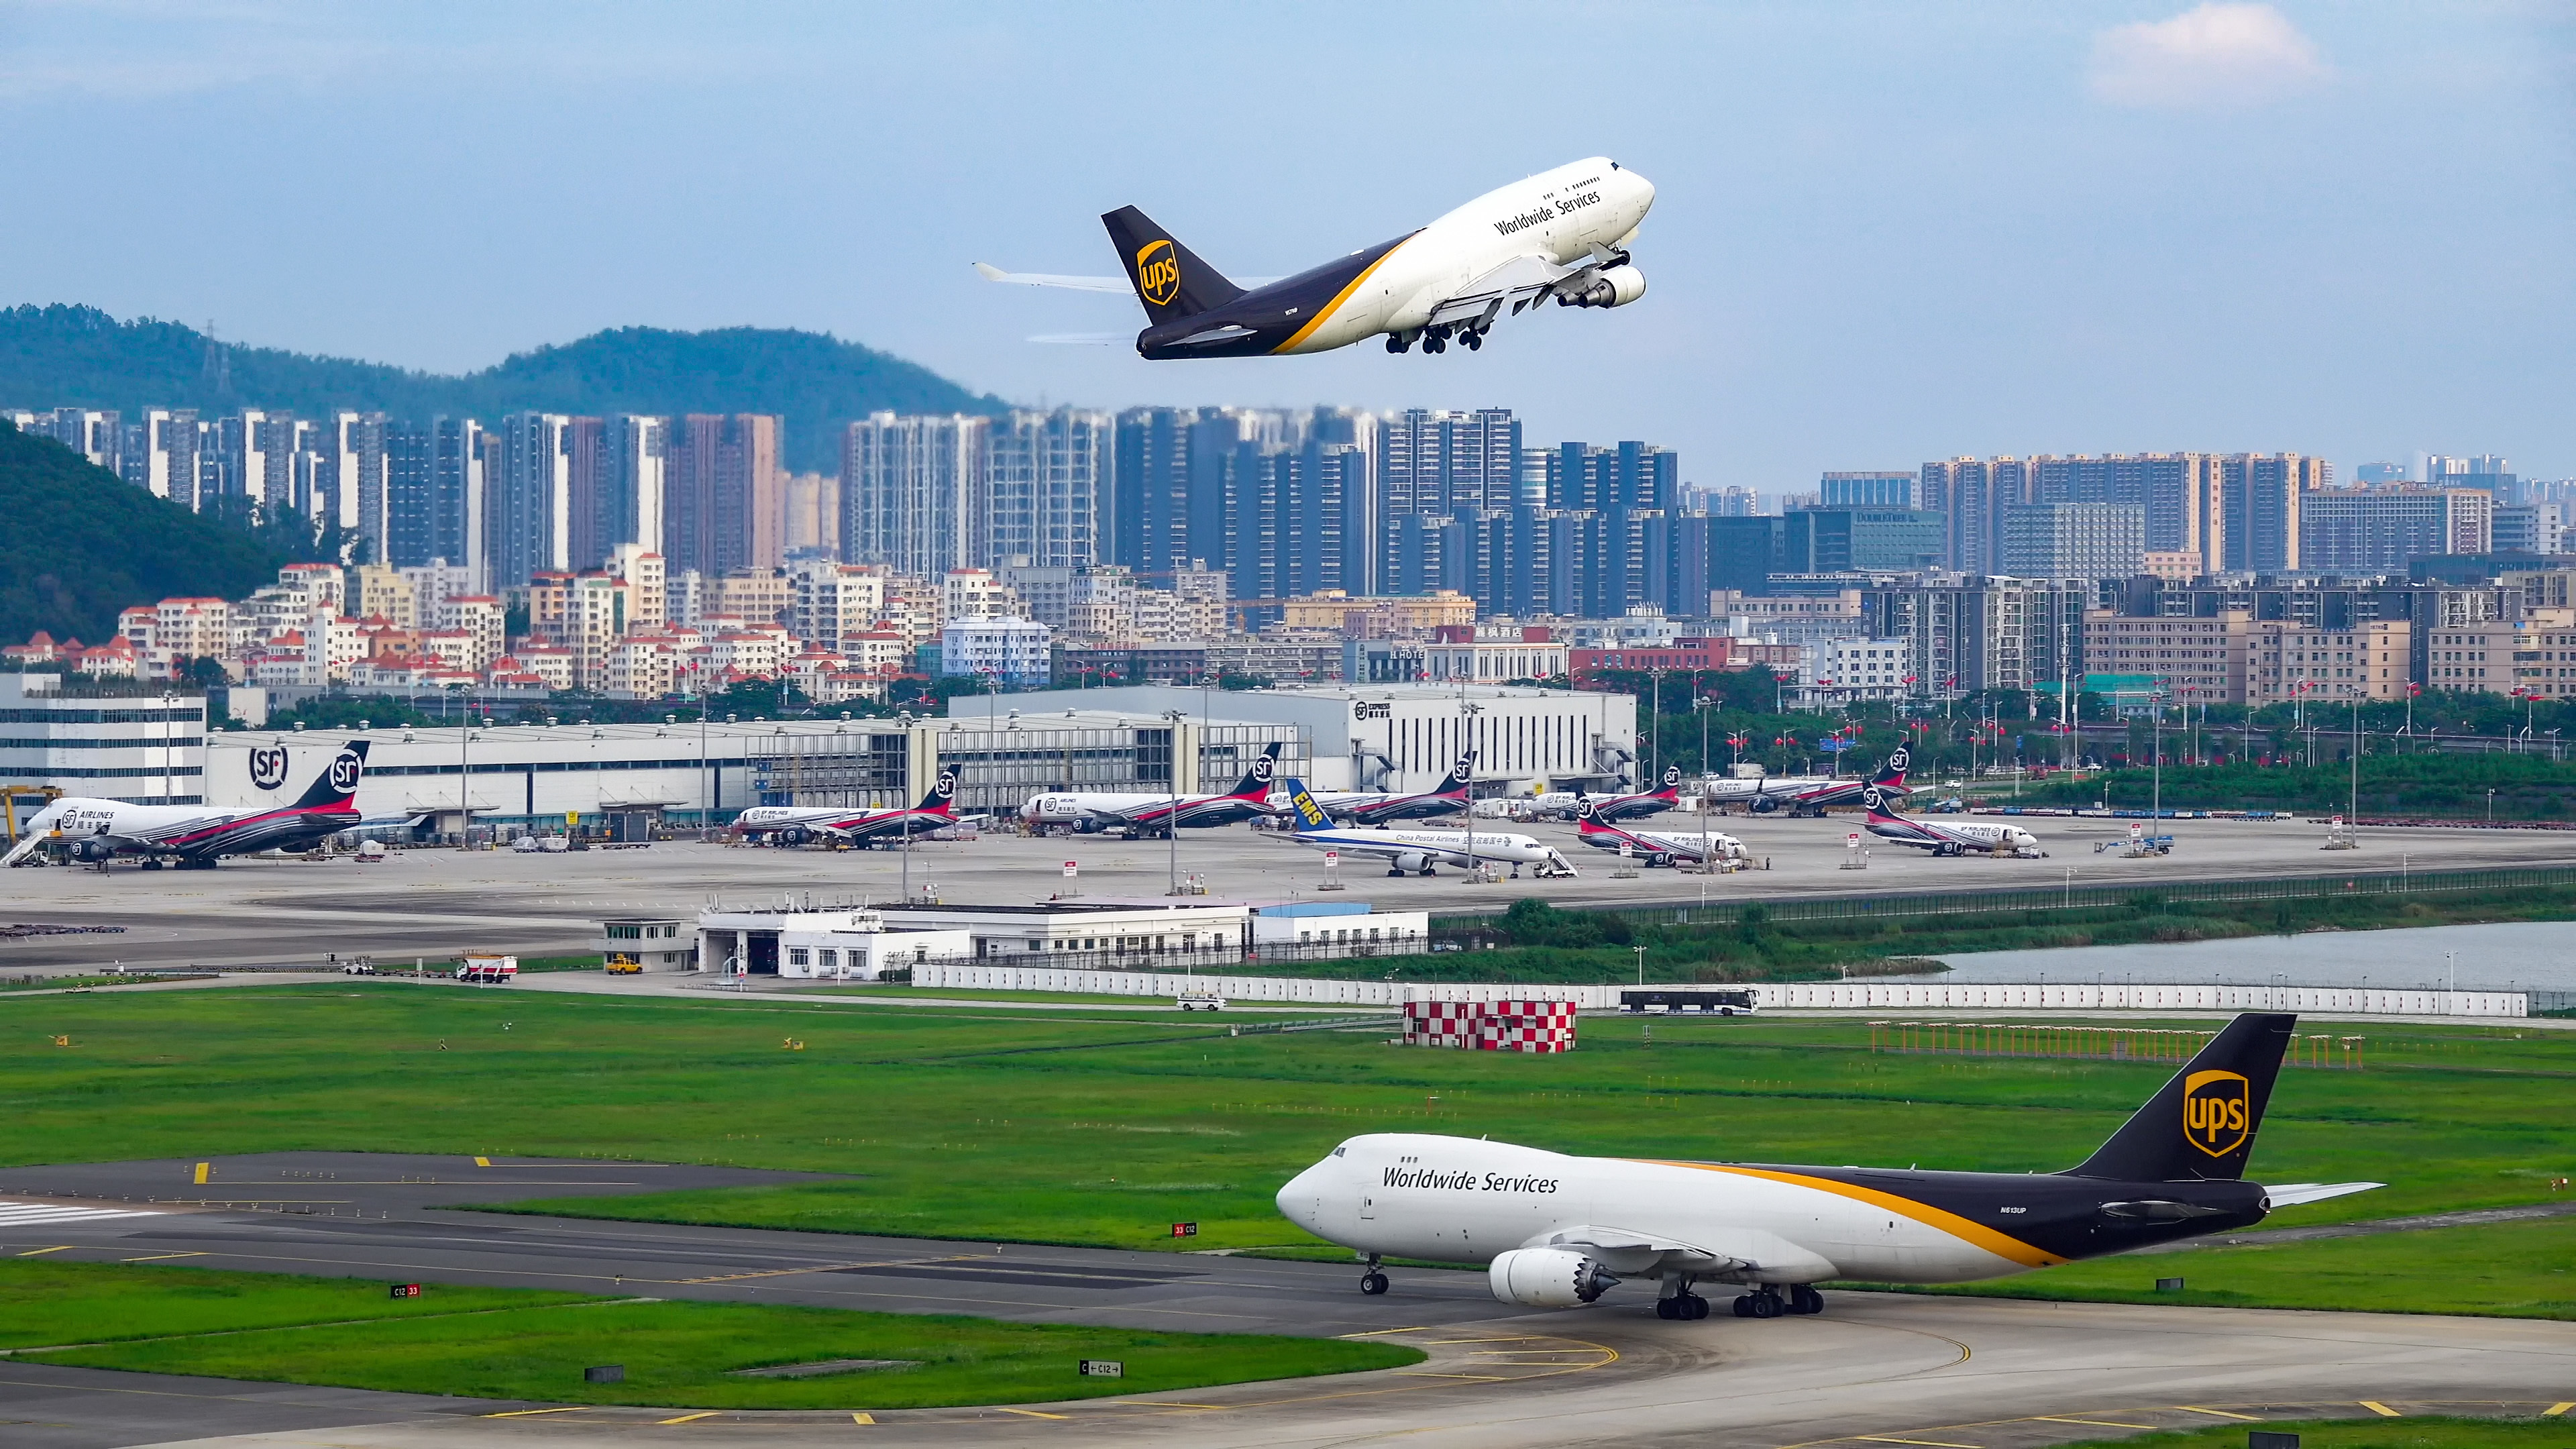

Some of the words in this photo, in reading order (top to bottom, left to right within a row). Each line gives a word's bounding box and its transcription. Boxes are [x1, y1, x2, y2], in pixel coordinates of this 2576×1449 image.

[1494, 207, 1554, 235] Worldwide
[1556, 191, 1601, 215] Services
[1399, 651, 1424, 659] HOTE
[1293, 792, 1323, 826] EMS
[80, 810, 115, 819] AIRLINES
[1384, 1167, 1477, 1190] Worldwide
[1482, 1172, 1559, 1193] Services
[1185, 1225, 1195, 1233] C12
[394, 1287, 406, 1296] C12
[409, 1287, 418, 1295] 33
[1082, 1363, 1087, 1372] C
[1098, 1364, 1111, 1373] C12
